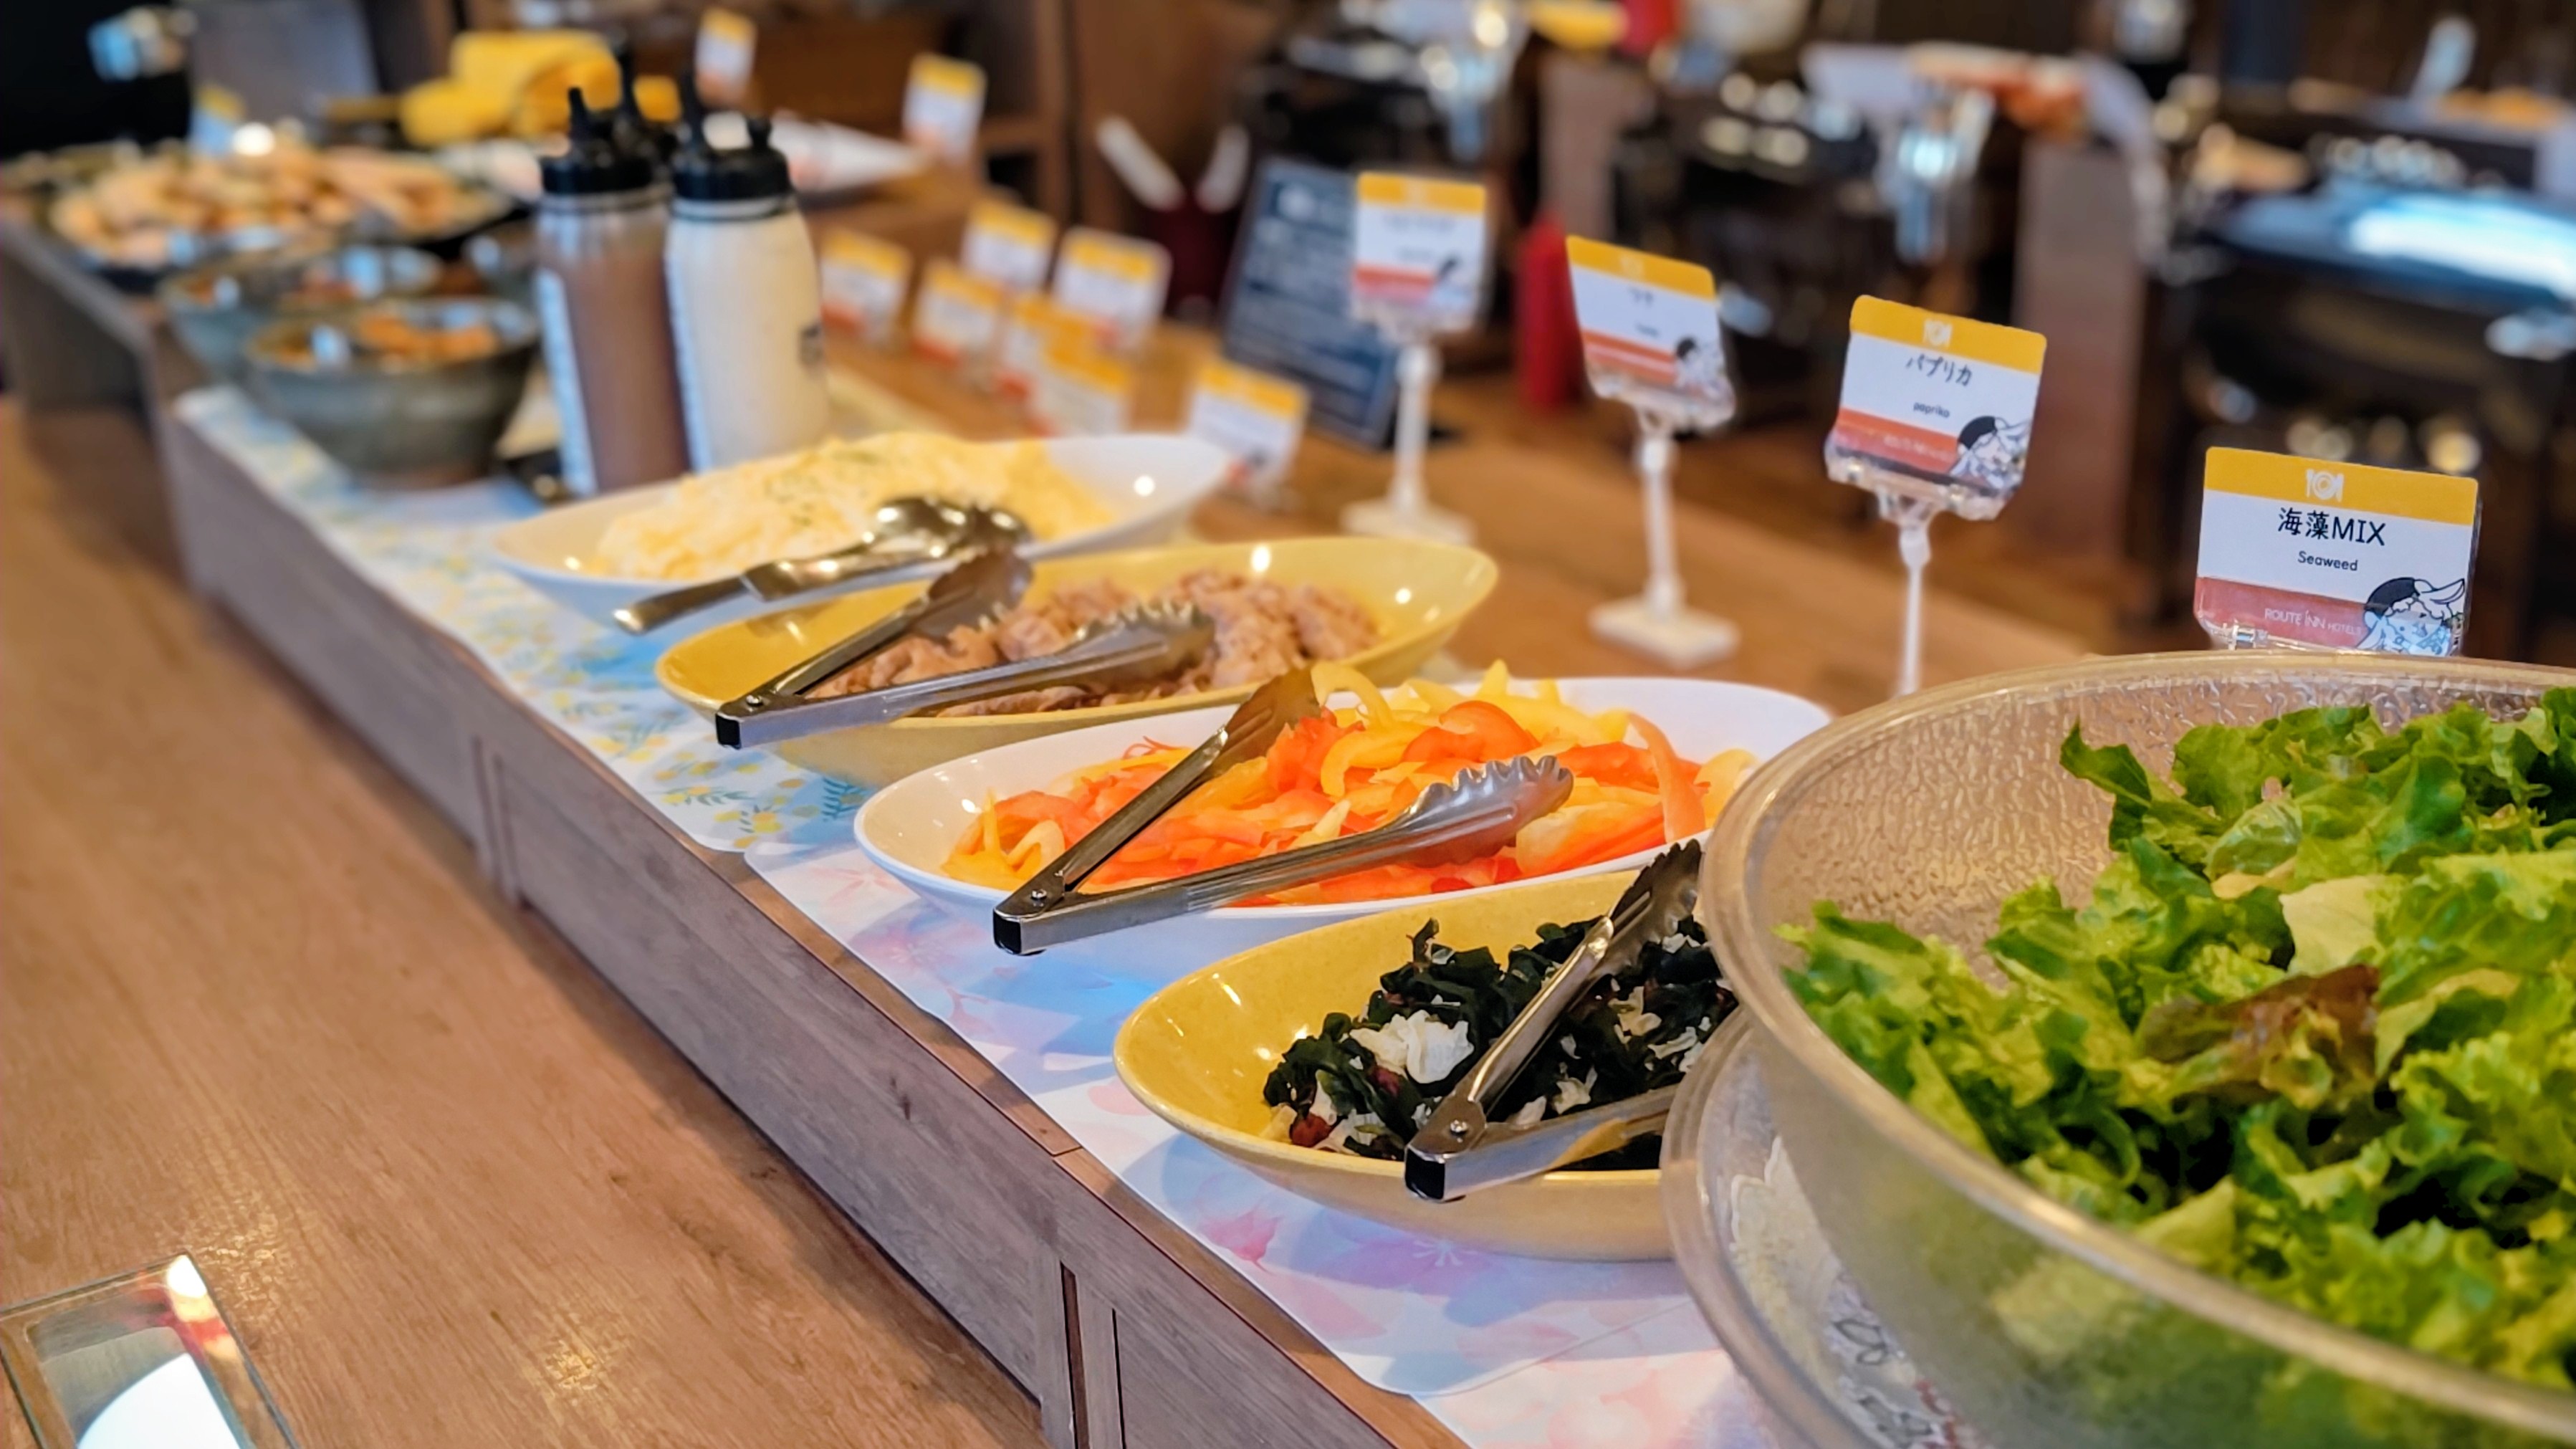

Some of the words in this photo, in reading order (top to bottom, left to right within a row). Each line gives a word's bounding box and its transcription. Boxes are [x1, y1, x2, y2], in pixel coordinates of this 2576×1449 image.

[1906, 353, 1972, 386] パプリカ
[2278, 507, 2386, 546] 海藻MIX
[2297, 550, 2359, 571] Seaweed
[2264, 608, 2302, 626] ROUTE
[2327, 623, 2362, 636] HOTELS
